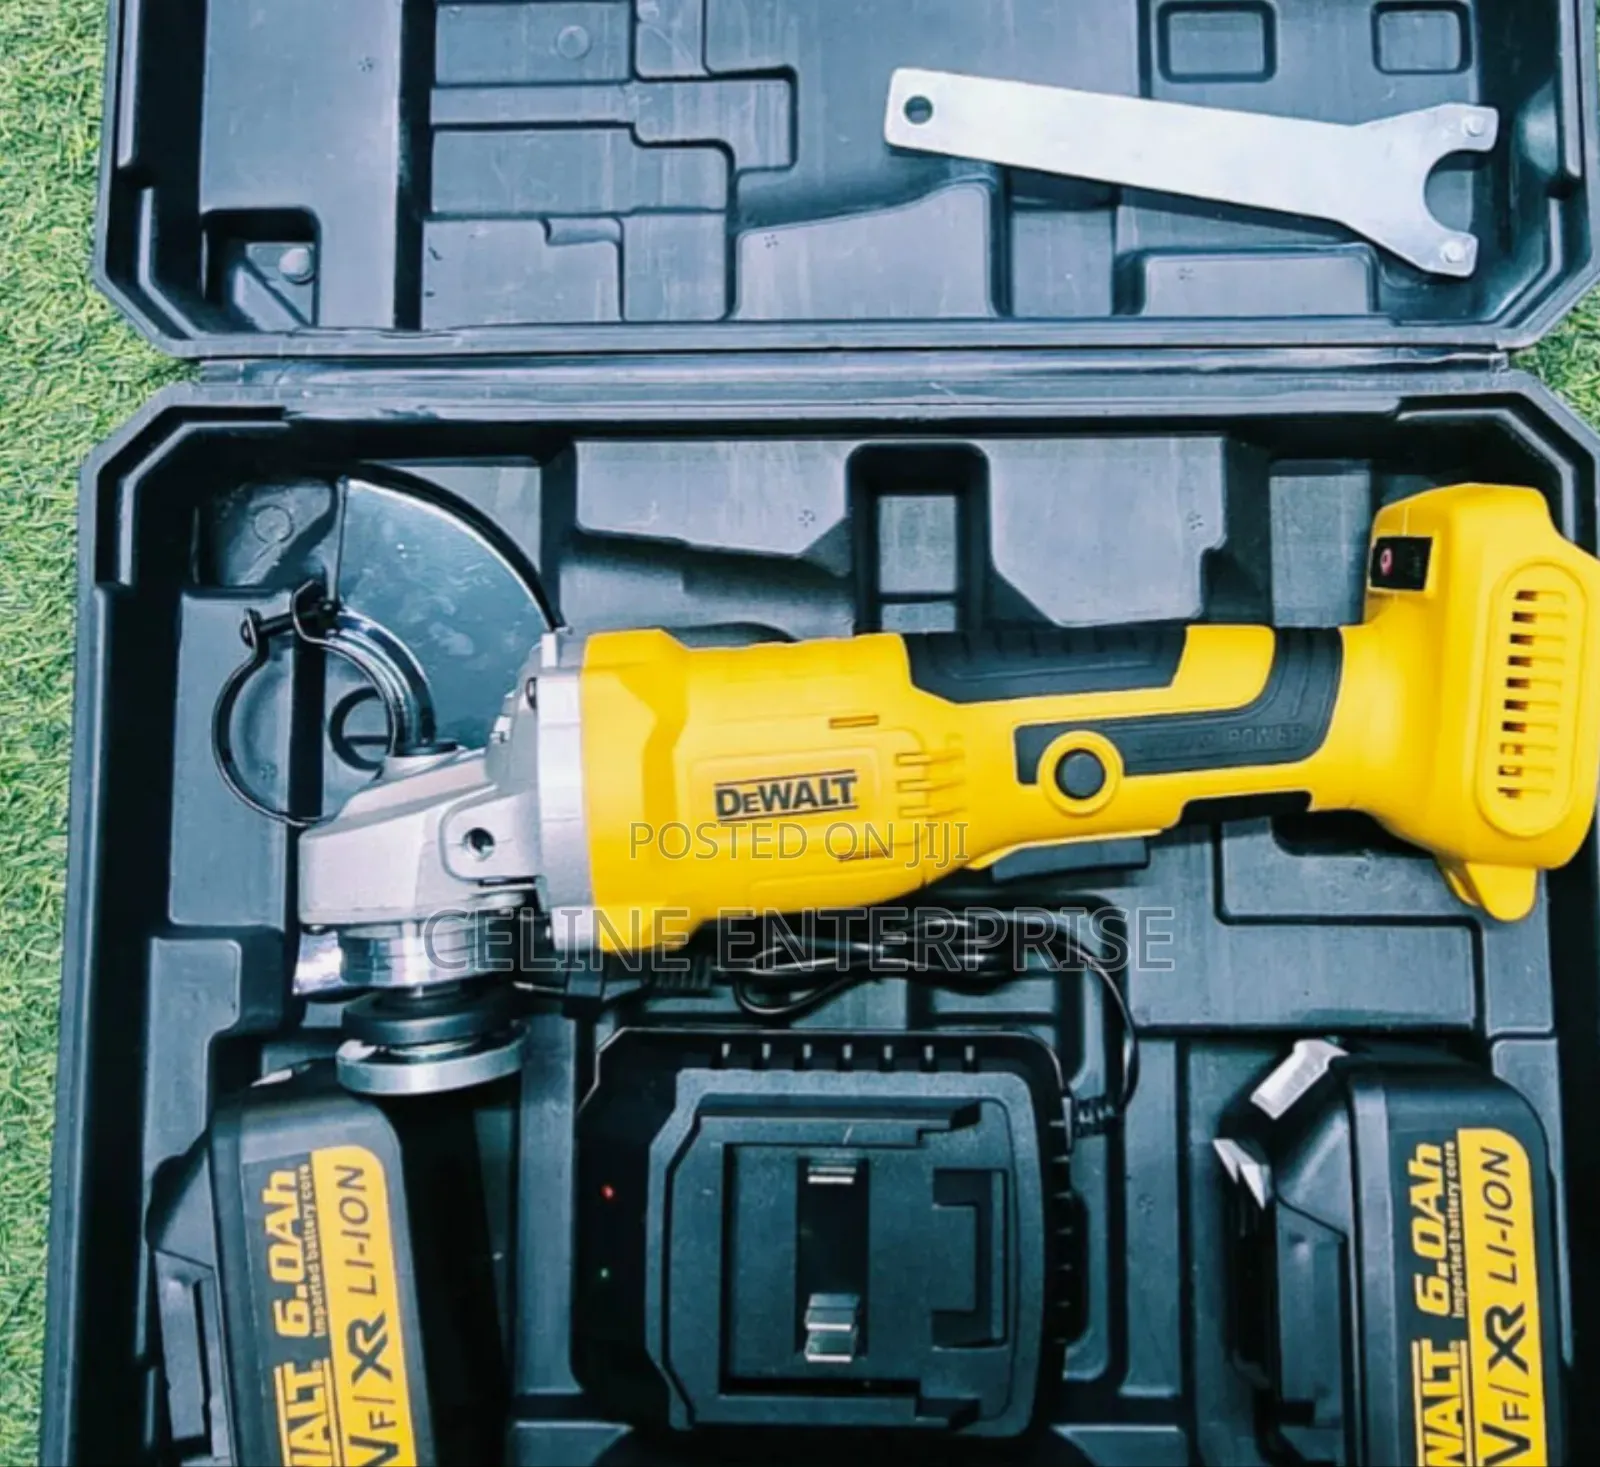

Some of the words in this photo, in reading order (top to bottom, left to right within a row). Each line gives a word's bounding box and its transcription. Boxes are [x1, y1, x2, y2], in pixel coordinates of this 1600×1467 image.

[299, 1163, 314, 1200] core
[1444, 1140, 1458, 1178] core
[302, 1203, 320, 1262] battery
[334, 1164, 377, 1296] LI-ION
[1408, 1143, 1450, 1316] 6.0Ah
[1446, 1180, 1461, 1241] battery
[1480, 1146, 1518, 1285] LI-ION
[262, 1170, 310, 1338] 6.0Ah
[1448, 1242, 1466, 1318] Imported
[347, 1310, 393, 1387] XR
[1484, 1302, 1529, 1376] XR
